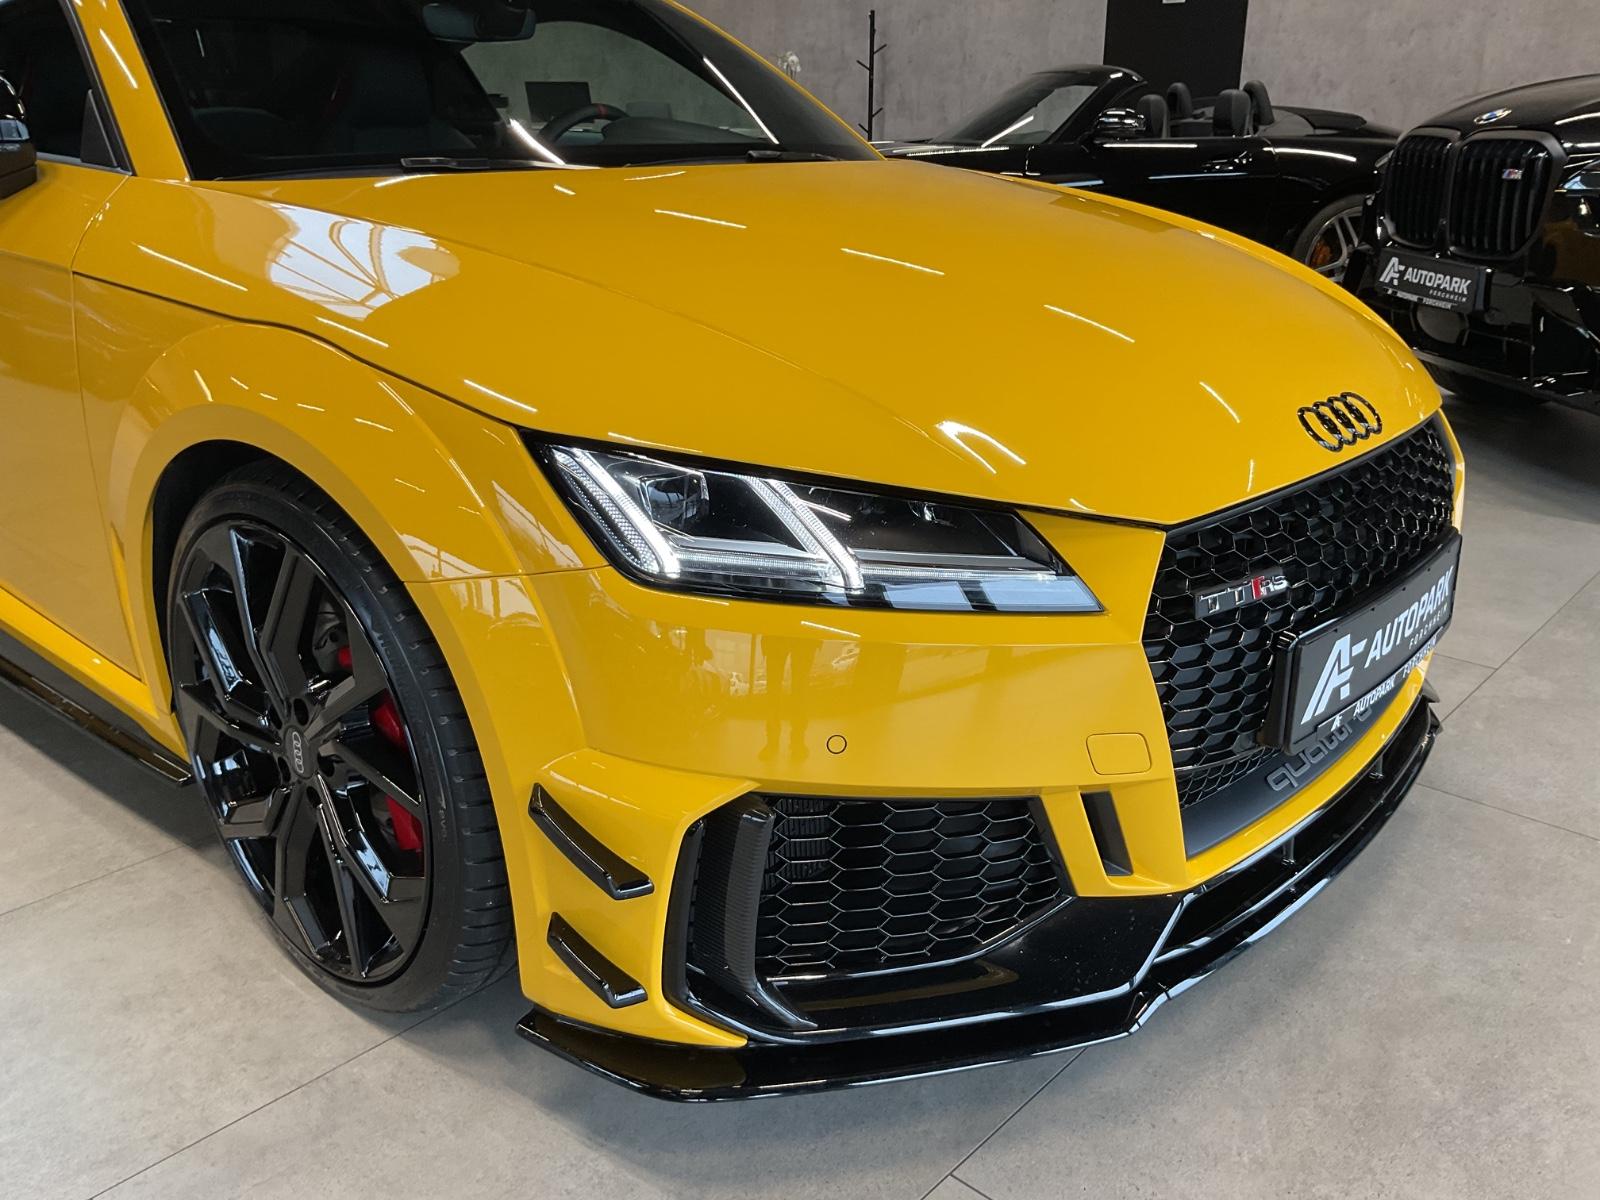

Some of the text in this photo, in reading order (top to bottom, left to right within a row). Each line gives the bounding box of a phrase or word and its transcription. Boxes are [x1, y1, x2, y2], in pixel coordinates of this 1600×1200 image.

[1404, 267, 1471, 295] AUTOPARK
[1364, 566, 1454, 668] AUTOPARK
[1409, 602, 1448, 650] FORCHHEIM
[1353, 675, 1395, 717] AUTOPARK
